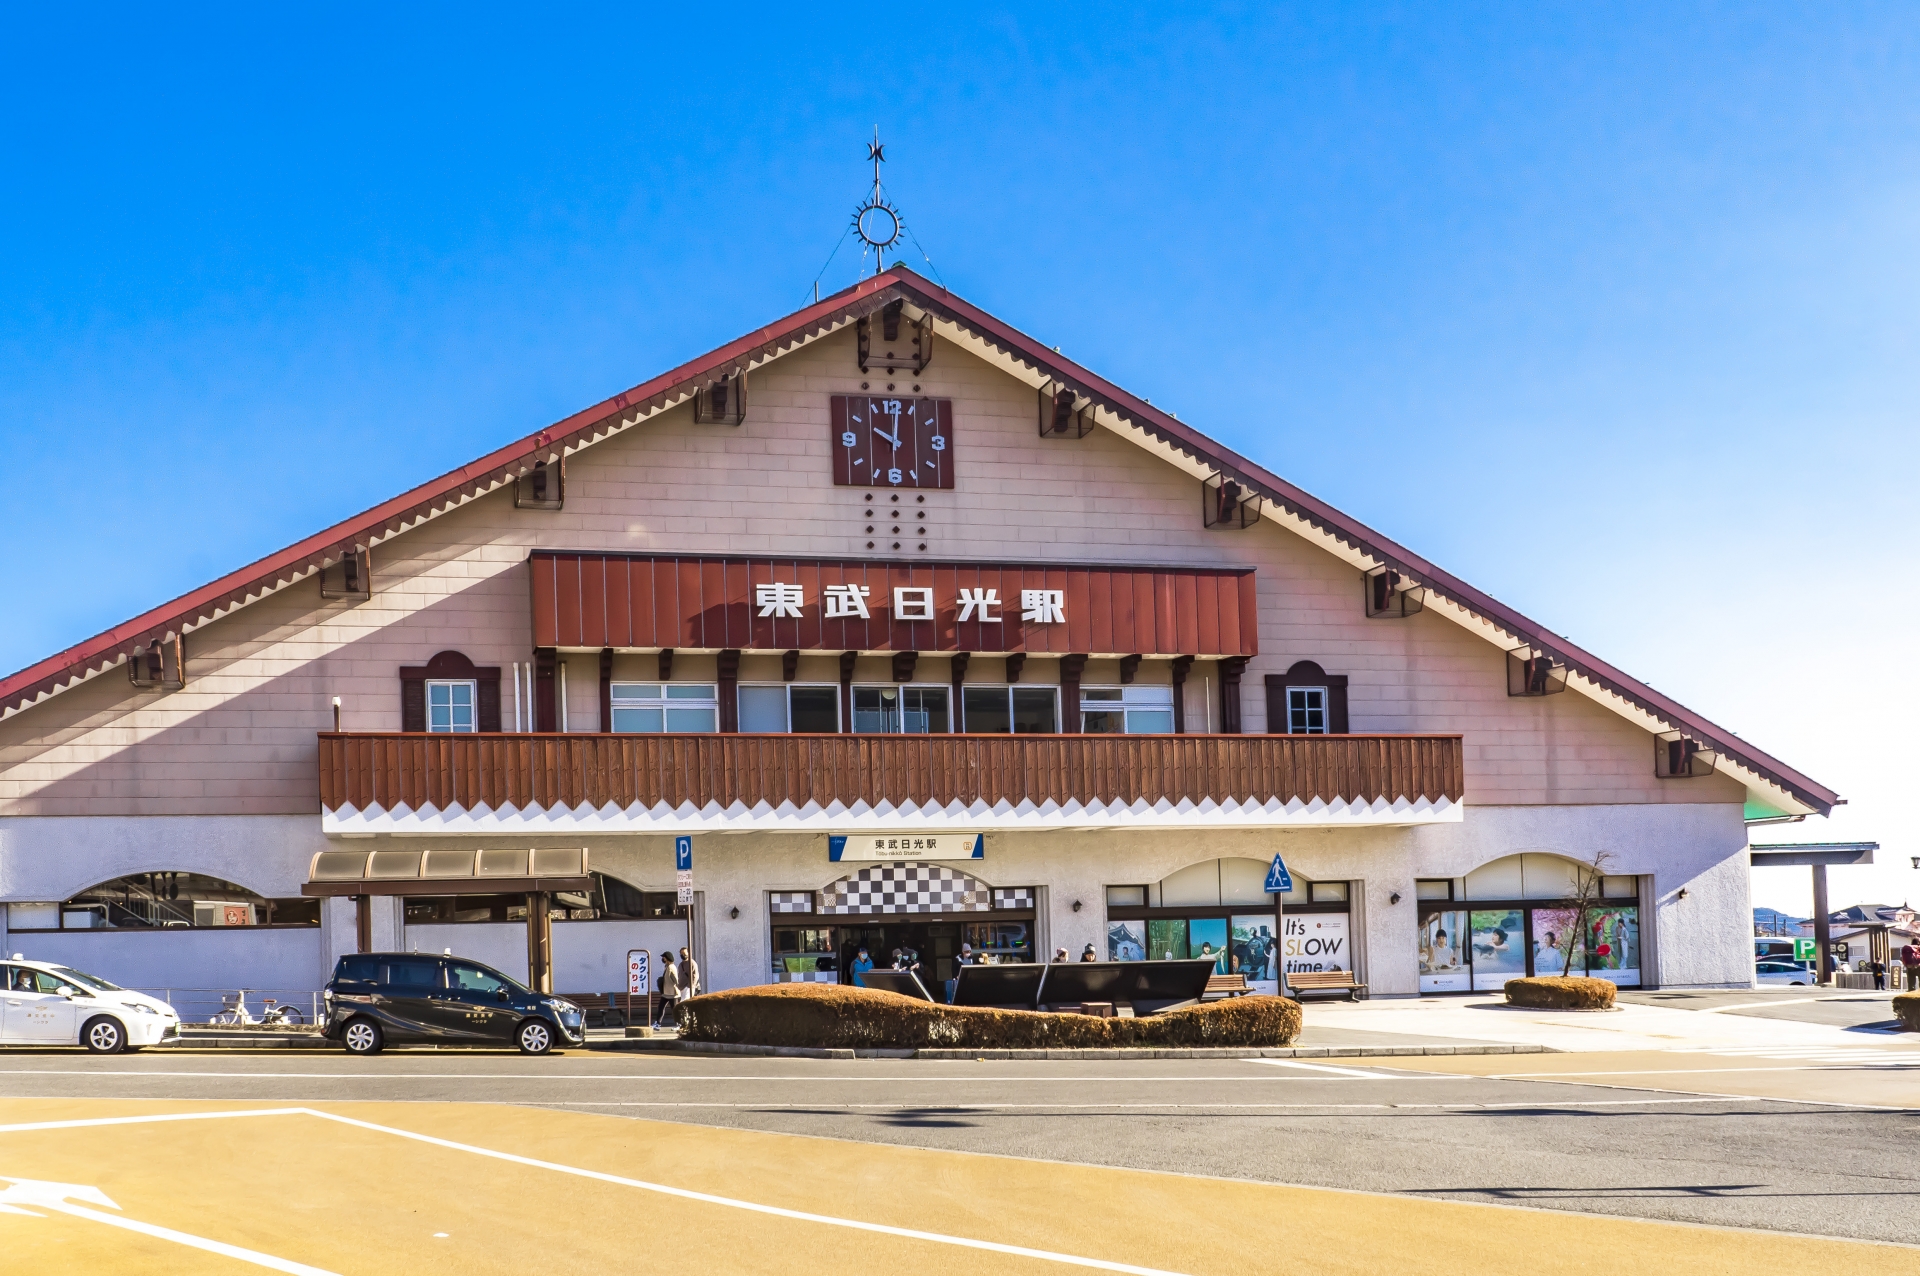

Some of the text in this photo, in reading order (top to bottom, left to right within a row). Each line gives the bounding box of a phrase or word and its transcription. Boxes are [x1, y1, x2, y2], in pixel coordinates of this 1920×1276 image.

[883, 400, 901, 415] 12
[842, 431, 857, 447] 9
[931, 434, 945, 451] 3
[888, 468, 902, 484] 6
[756, 582, 1066, 624] 東武日光駅
[679, 839, 689, 866] P
[875, 838, 937, 850] 東武日光駅
[1285, 918, 1306, 936] It's
[1285, 937, 1343, 956] SLOW
[1800, 940, 1816, 954] P
[639, 957, 647, 989] タクシー
[1286, 959, 1323, 973] time
[631, 962, 639, 993] のりば
